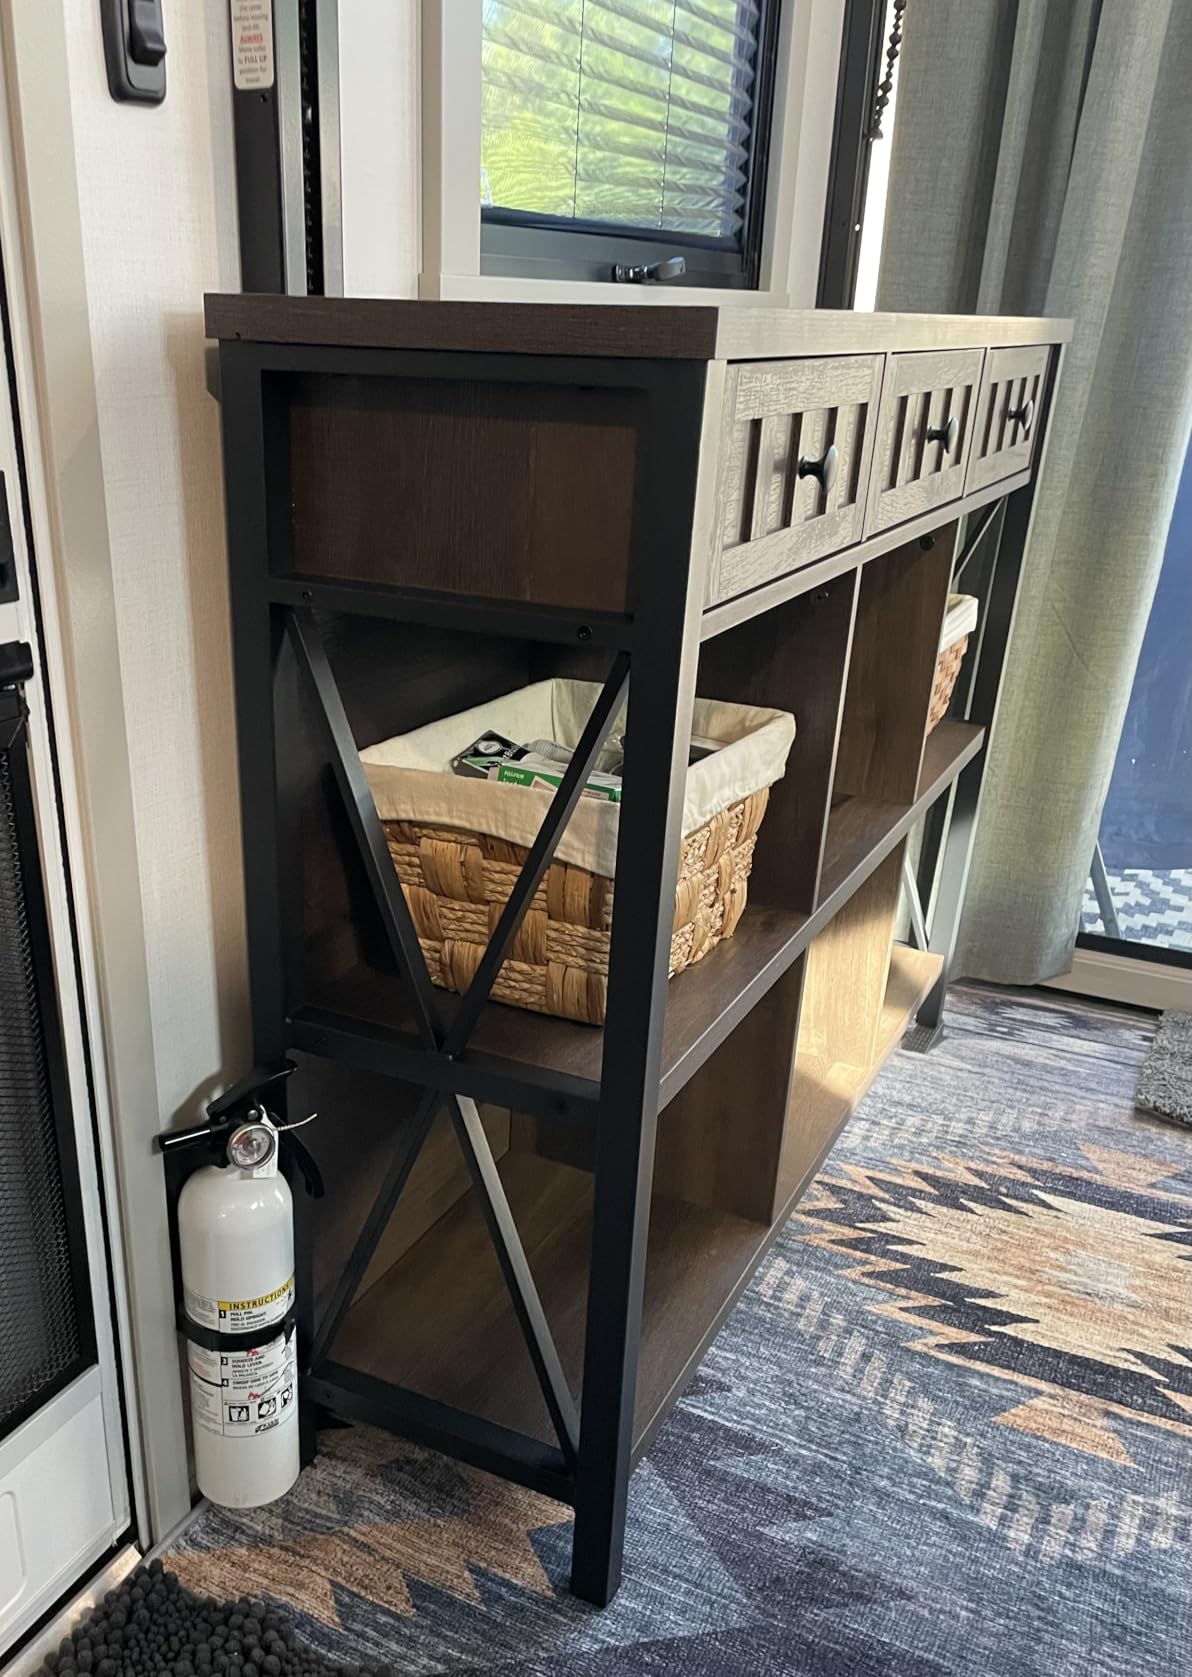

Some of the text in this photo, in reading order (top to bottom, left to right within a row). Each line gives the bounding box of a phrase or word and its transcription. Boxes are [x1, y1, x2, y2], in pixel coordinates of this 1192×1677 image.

[240, 33, 263, 44] ALWAYS
[244, 55, 257, 64] FULL
[259, 54, 267, 63] UP
[229, 1285, 289, 1310] INSTRUCTIONS
